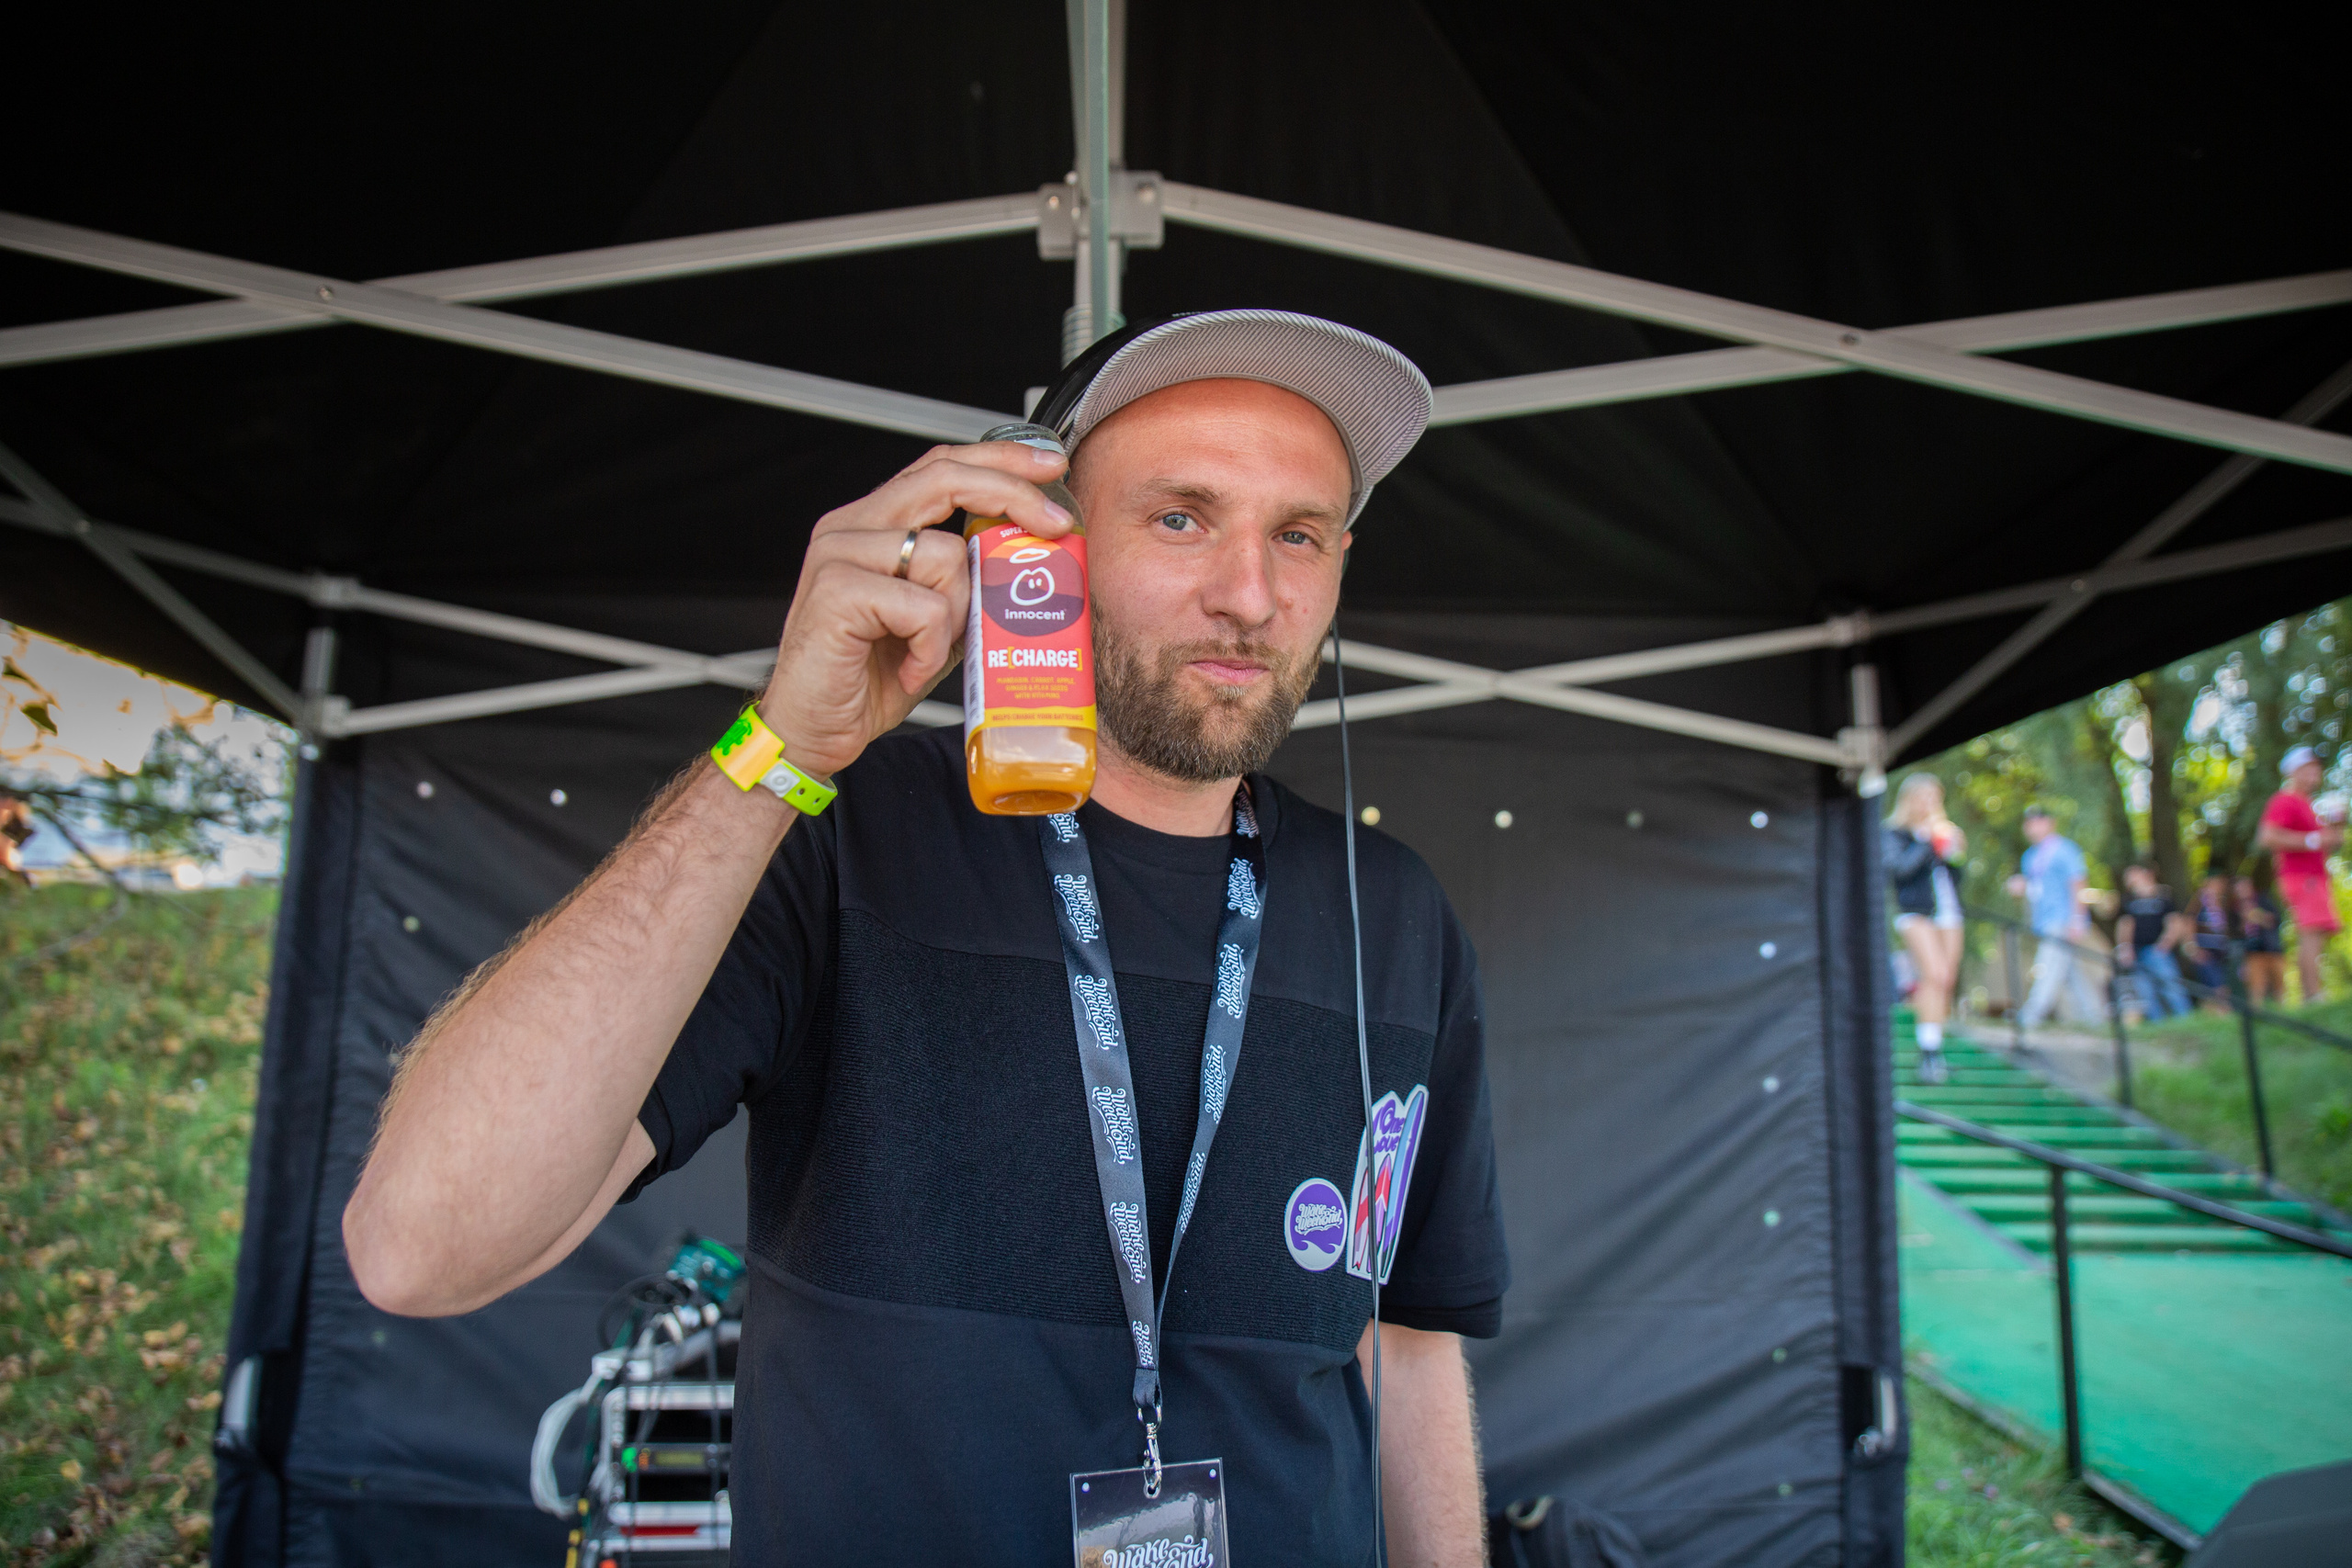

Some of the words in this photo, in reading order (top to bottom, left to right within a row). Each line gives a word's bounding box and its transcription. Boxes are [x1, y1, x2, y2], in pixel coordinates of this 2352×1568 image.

[1000, 526, 1023, 537] SUPER
[1004, 609, 1065, 621] innocent
[1374, 1099, 1406, 1135] One
[1365, 1135, 1400, 1157] ove
[1298, 1203, 1328, 1218] Wake
